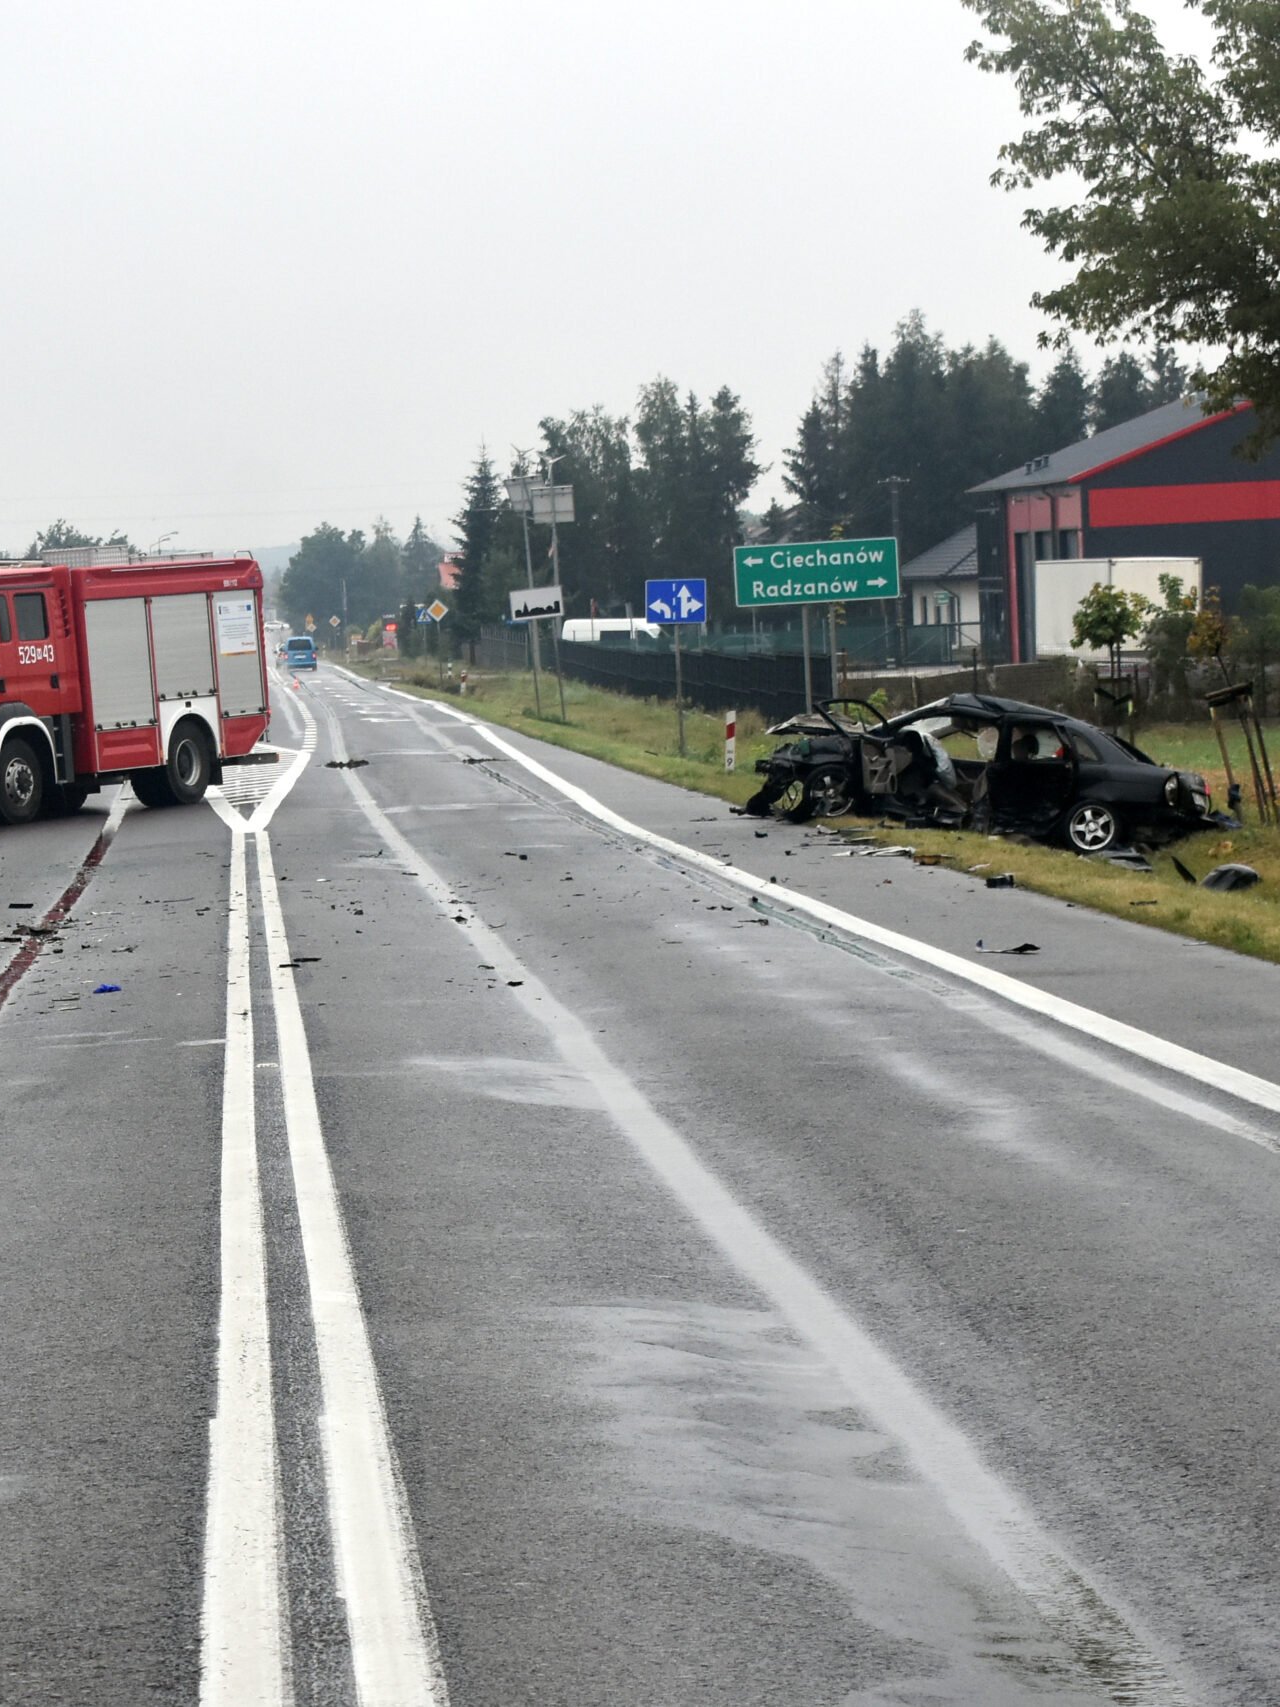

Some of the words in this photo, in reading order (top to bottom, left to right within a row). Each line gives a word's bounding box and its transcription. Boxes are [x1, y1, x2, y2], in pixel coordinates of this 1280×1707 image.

[770, 546, 884, 569] Ciechanów
[752, 576, 858, 599] Radzanów
[727, 757, 733, 767] 9
